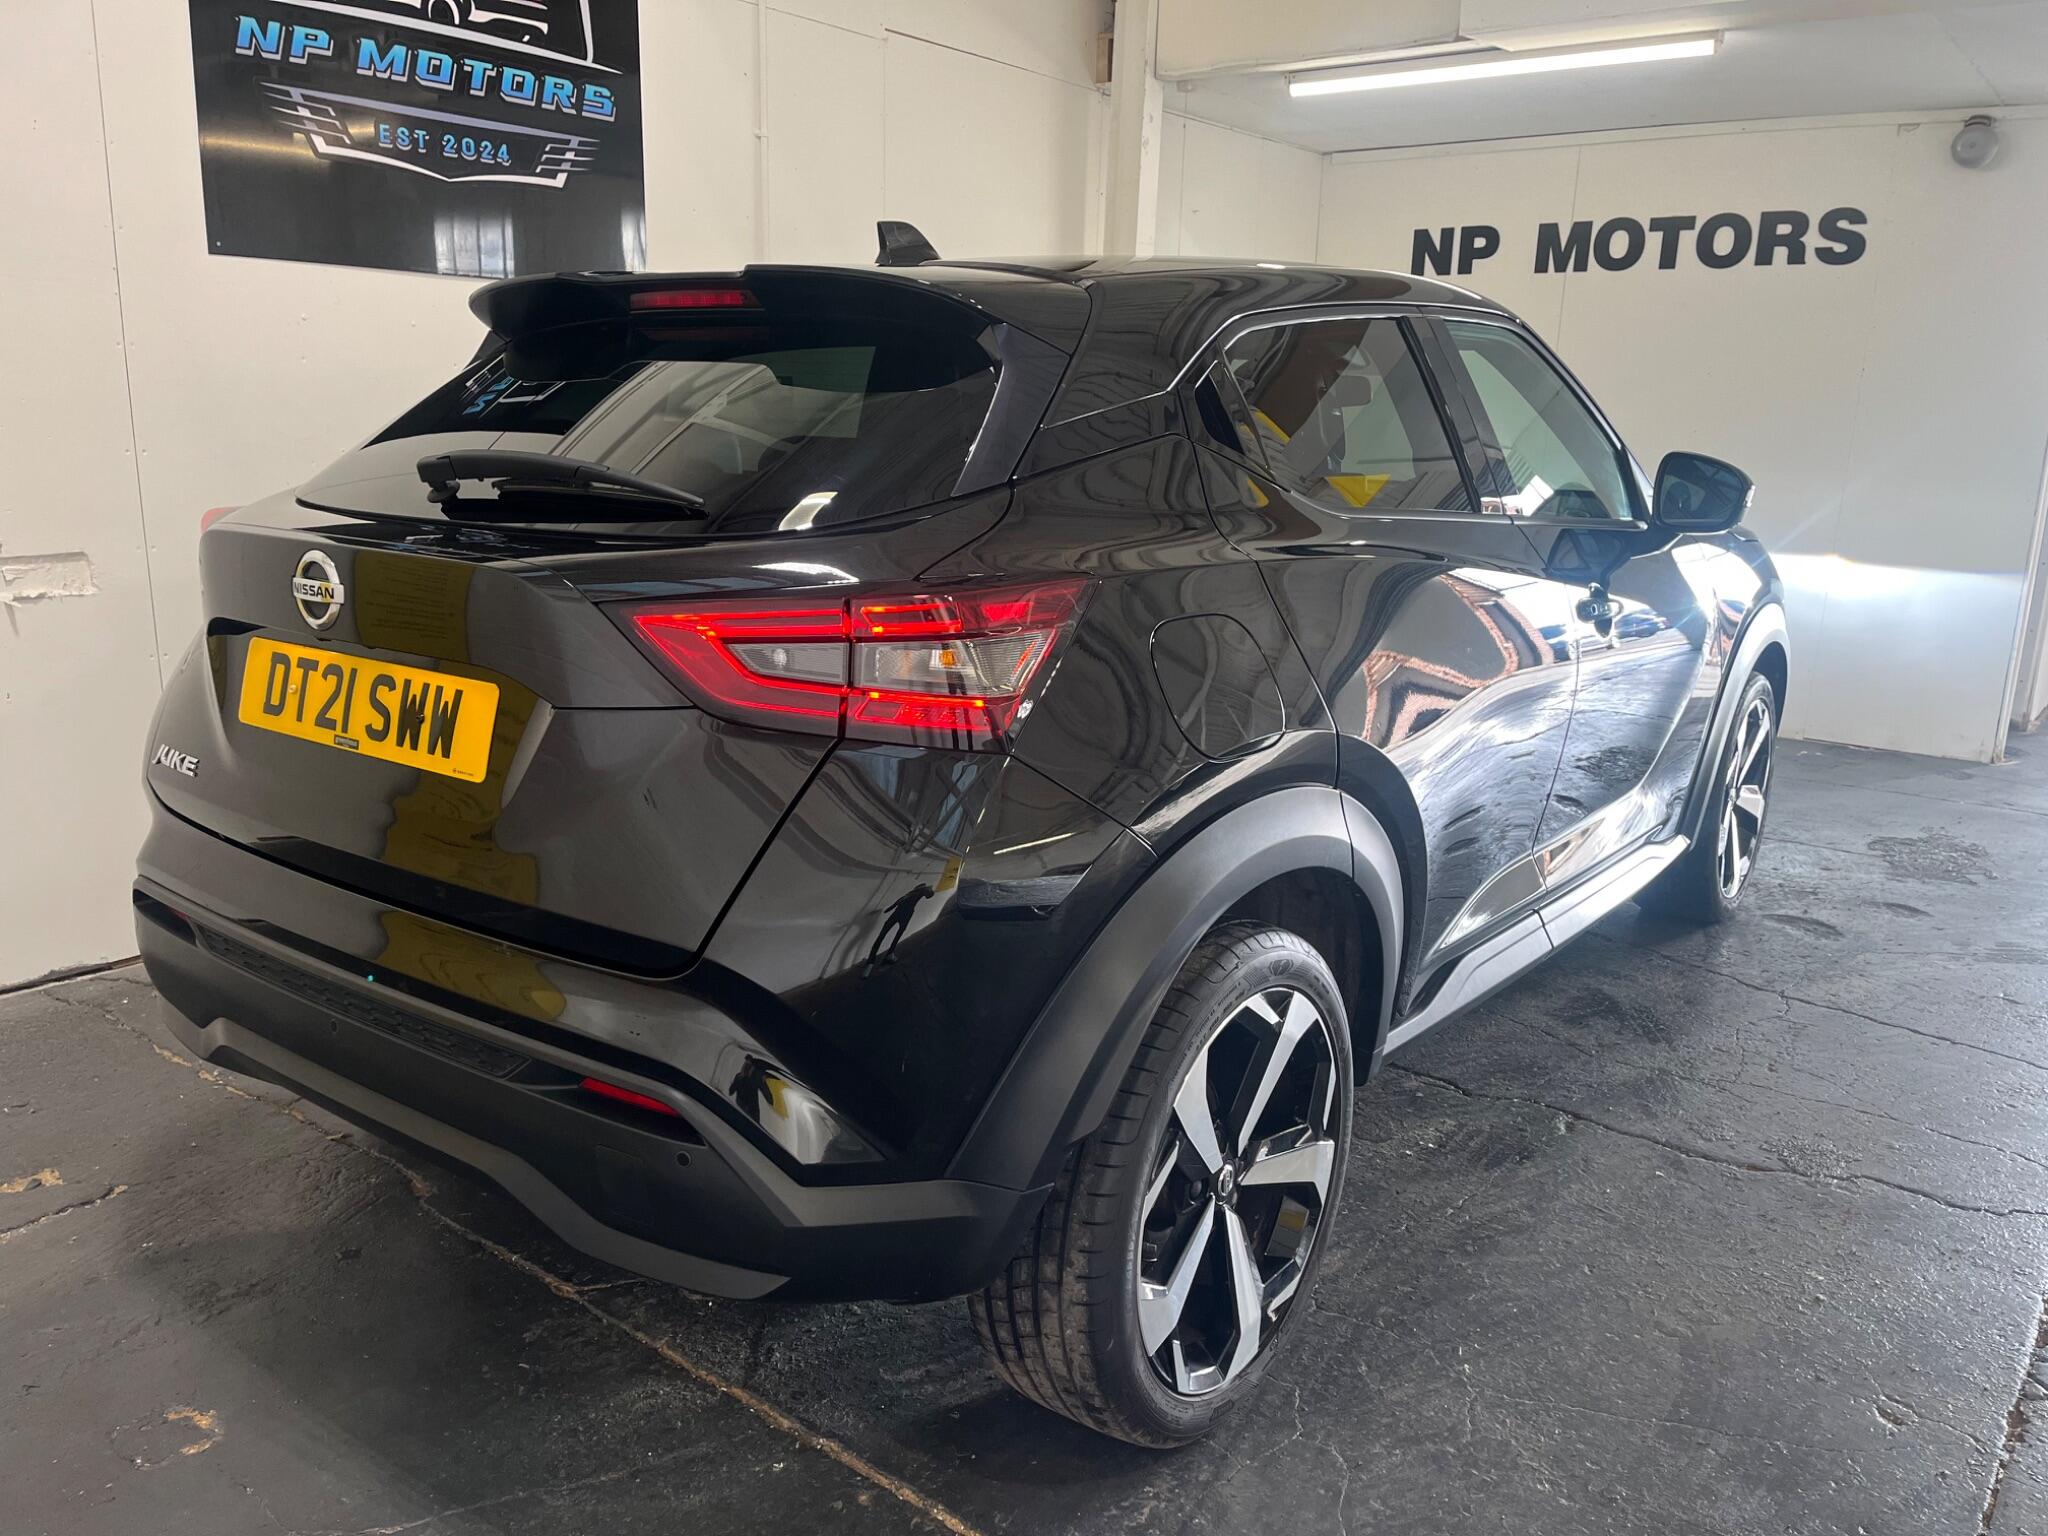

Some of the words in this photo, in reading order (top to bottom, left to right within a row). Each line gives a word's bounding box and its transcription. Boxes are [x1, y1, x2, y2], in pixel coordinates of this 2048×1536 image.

[235, 15, 333, 63] NP
[357, 37, 616, 122] MOTORS
[379, 123, 429, 152] EST
[443, 135, 511, 166] 2024
[1411, 225, 1500, 276] NP
[1534, 207, 1867, 273] MOTORS
[294, 582, 334, 600] NISSAN
[262, 651, 358, 734] DT21
[364, 673, 464, 760] SWW
[151, 744, 199, 777] JUKE
